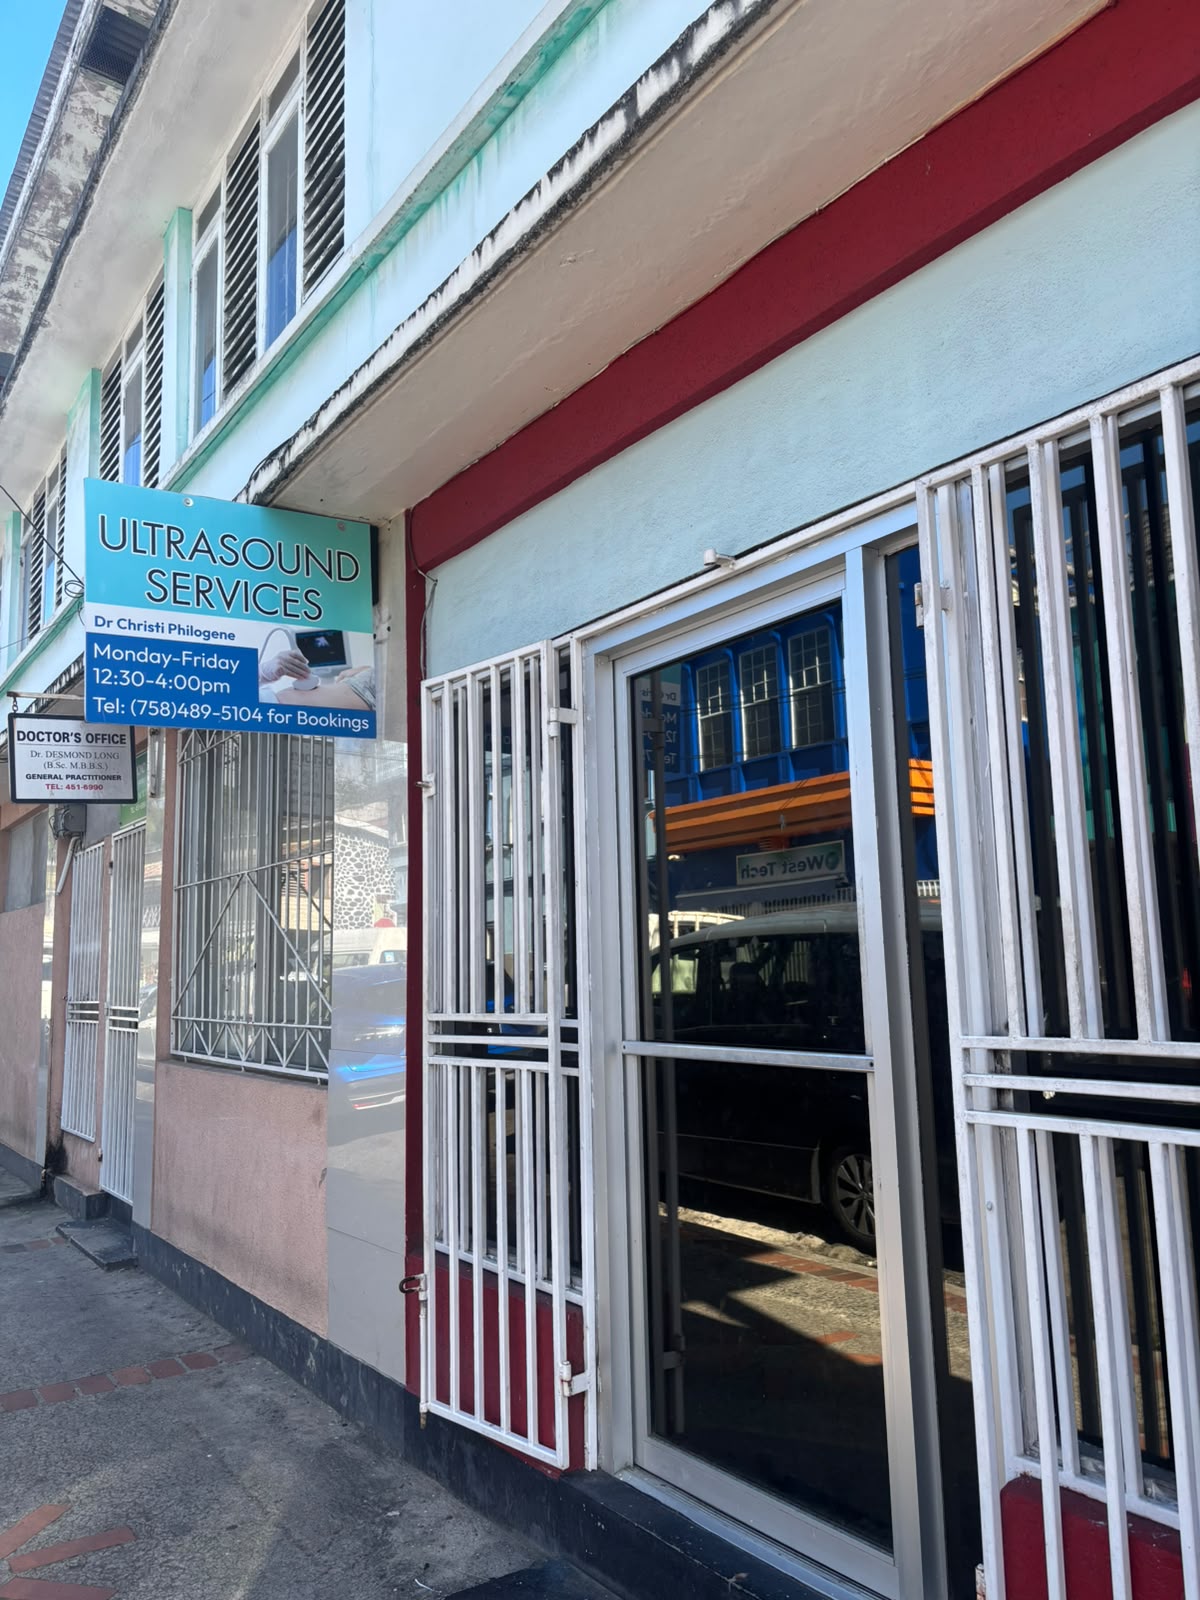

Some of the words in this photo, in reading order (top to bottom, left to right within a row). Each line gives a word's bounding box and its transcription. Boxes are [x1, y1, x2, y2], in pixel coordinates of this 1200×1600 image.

[99, 514, 360, 582] ULTRASOUND
[146, 567, 324, 621] SERVICES
[94, 615, 113, 628] Dr
[116, 618, 165, 634] Christi
[168, 623, 236, 641] Philogene
[93, 642, 240, 674] Monday-Friday
[92, 667, 231, 696] 12:30-4:00pm
[92, 696, 125, 714] Tel:
[130, 698, 263, 723] (758)489-5104
[266, 708, 293, 725] for
[297, 710, 369, 732] Bookings
[16, 730, 82, 744] DOCTOR'S
[85, 732, 127, 745] OFFICE
[30, 750, 43, 758] Dr.
[45, 750, 92, 759] DESMOND
[94, 751, 120, 760] LONG
